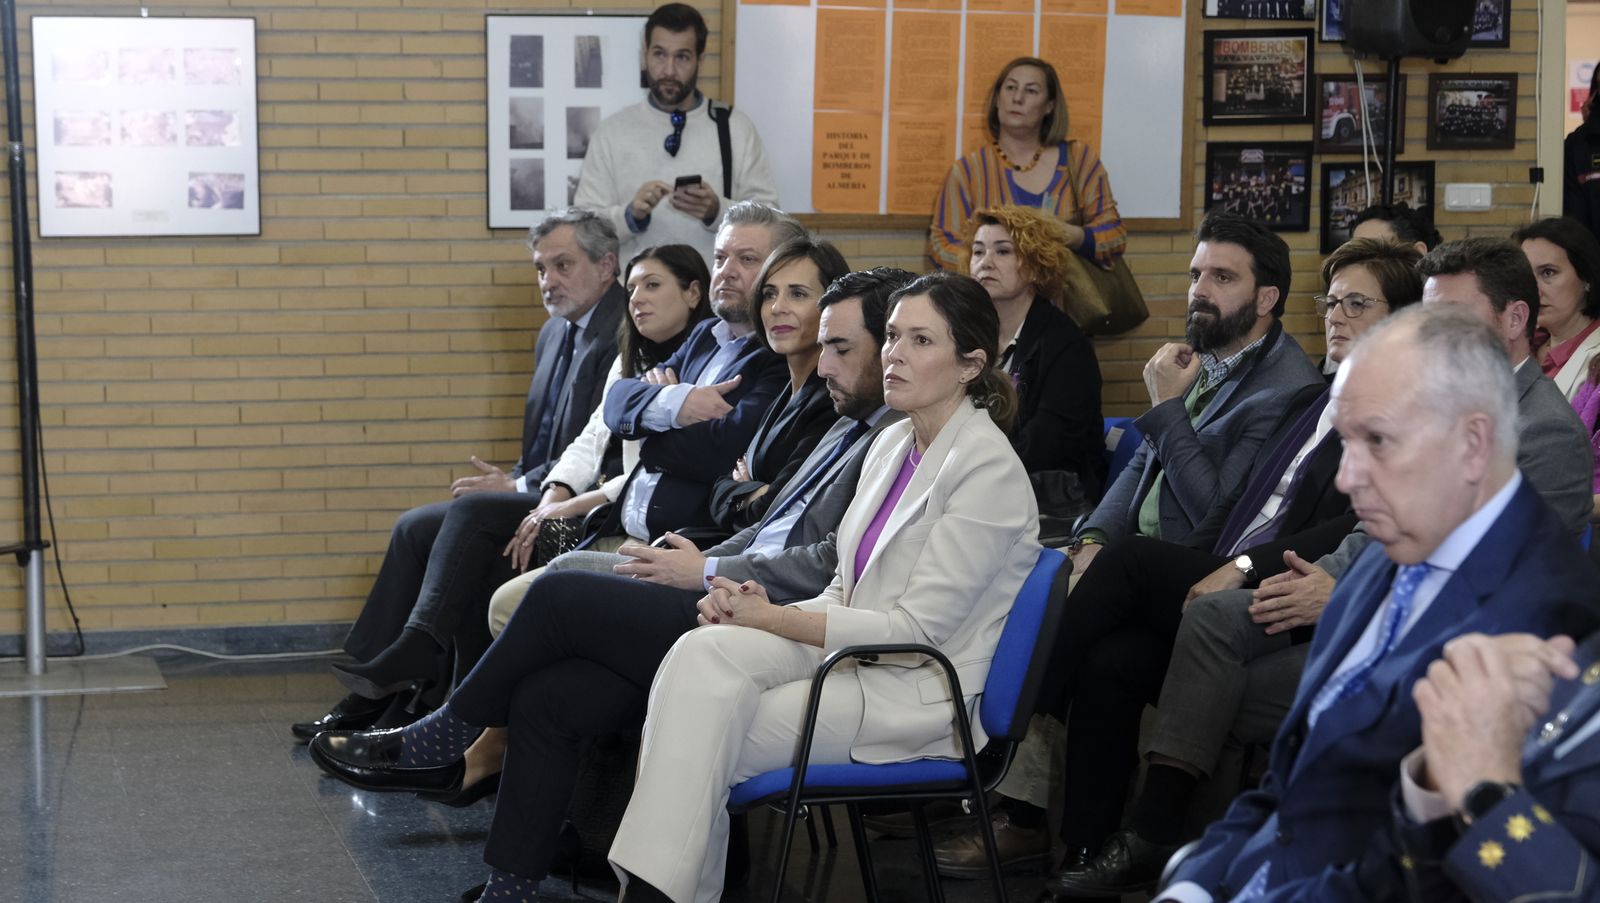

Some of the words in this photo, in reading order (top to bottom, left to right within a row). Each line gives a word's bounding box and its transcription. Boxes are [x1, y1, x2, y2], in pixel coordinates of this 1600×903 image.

[1223, 40, 1291, 54] BOMBEROS
[826, 132, 868, 140] HISTORIA
[838, 142, 854, 150] DEL
[822, 152, 857, 161] PARQUE
[860, 152, 870, 160] DE
[840, 172, 851, 180] DE
